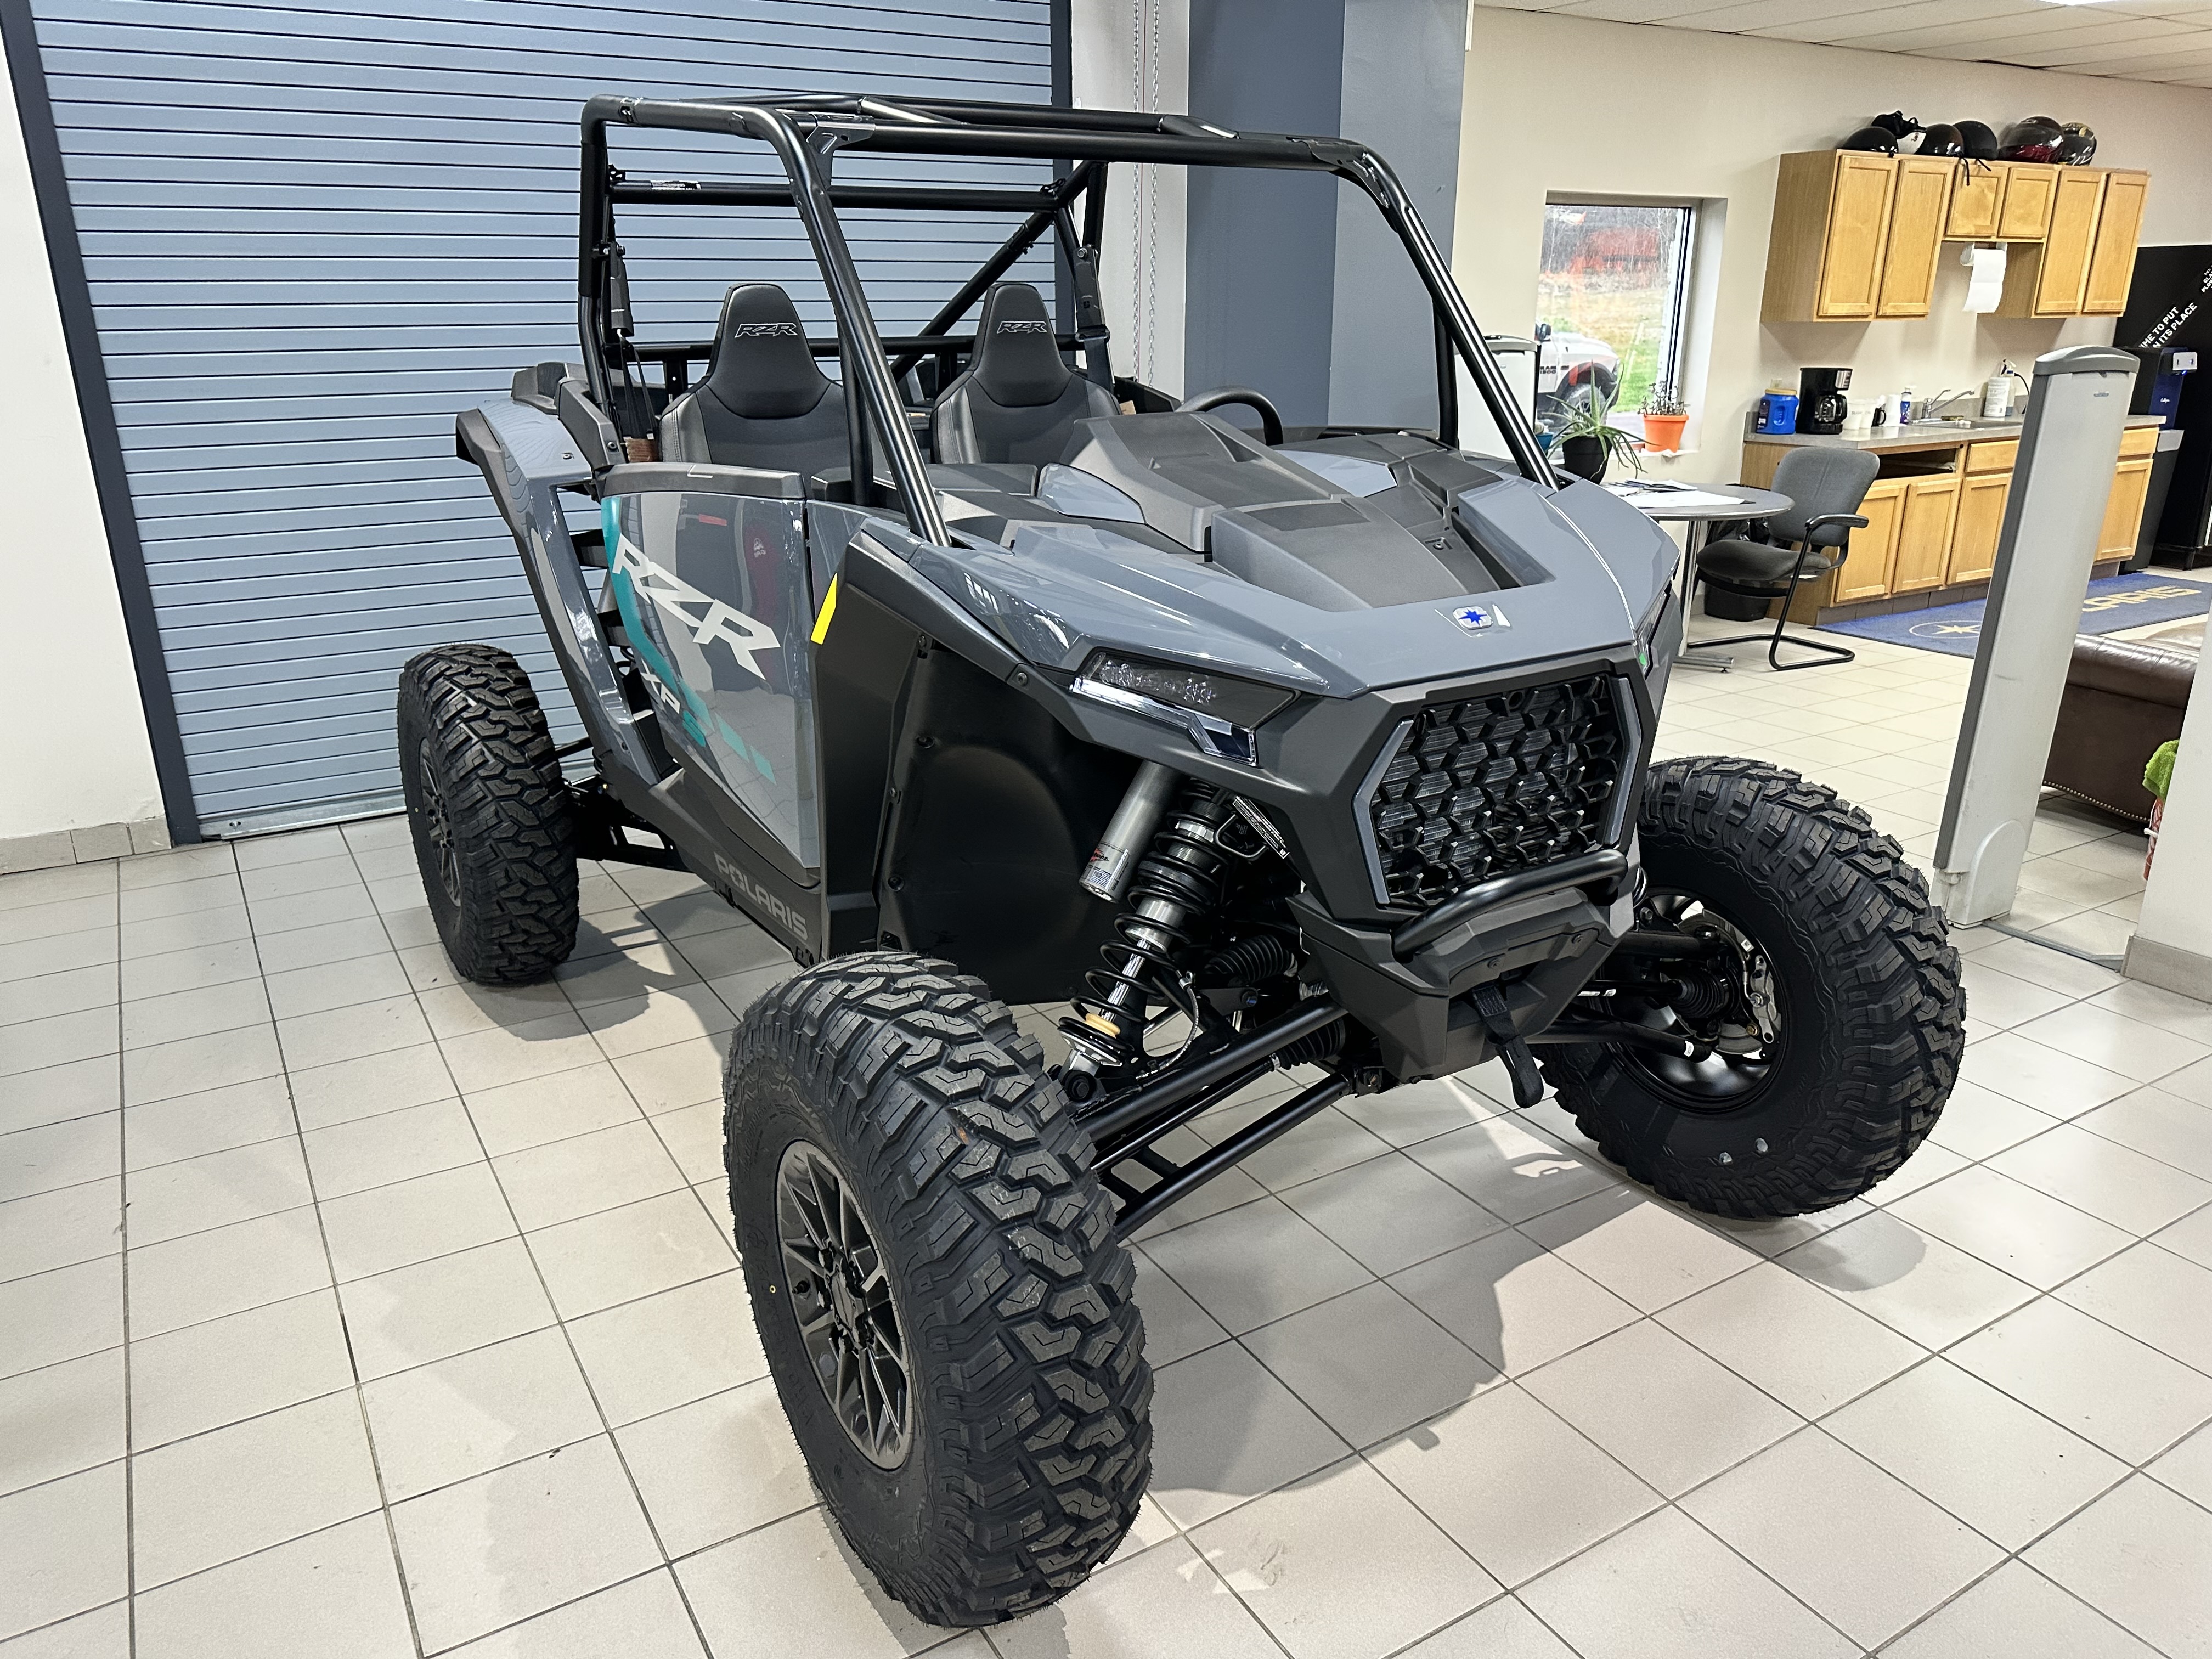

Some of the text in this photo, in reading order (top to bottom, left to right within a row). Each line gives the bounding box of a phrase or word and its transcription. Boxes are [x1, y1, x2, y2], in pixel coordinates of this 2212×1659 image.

[2203, 270, 2212, 284] GLA
[735, 322, 798, 338] RZR
[997, 321, 1047, 334] RZR
[2139, 307, 2179, 348] IME TO PUT
[2158, 329, 2173, 343] ITS
[2171, 302, 2198, 330] PLACE
[612, 533, 780, 680] RZR
[714, 851, 808, 940] POLARIS
